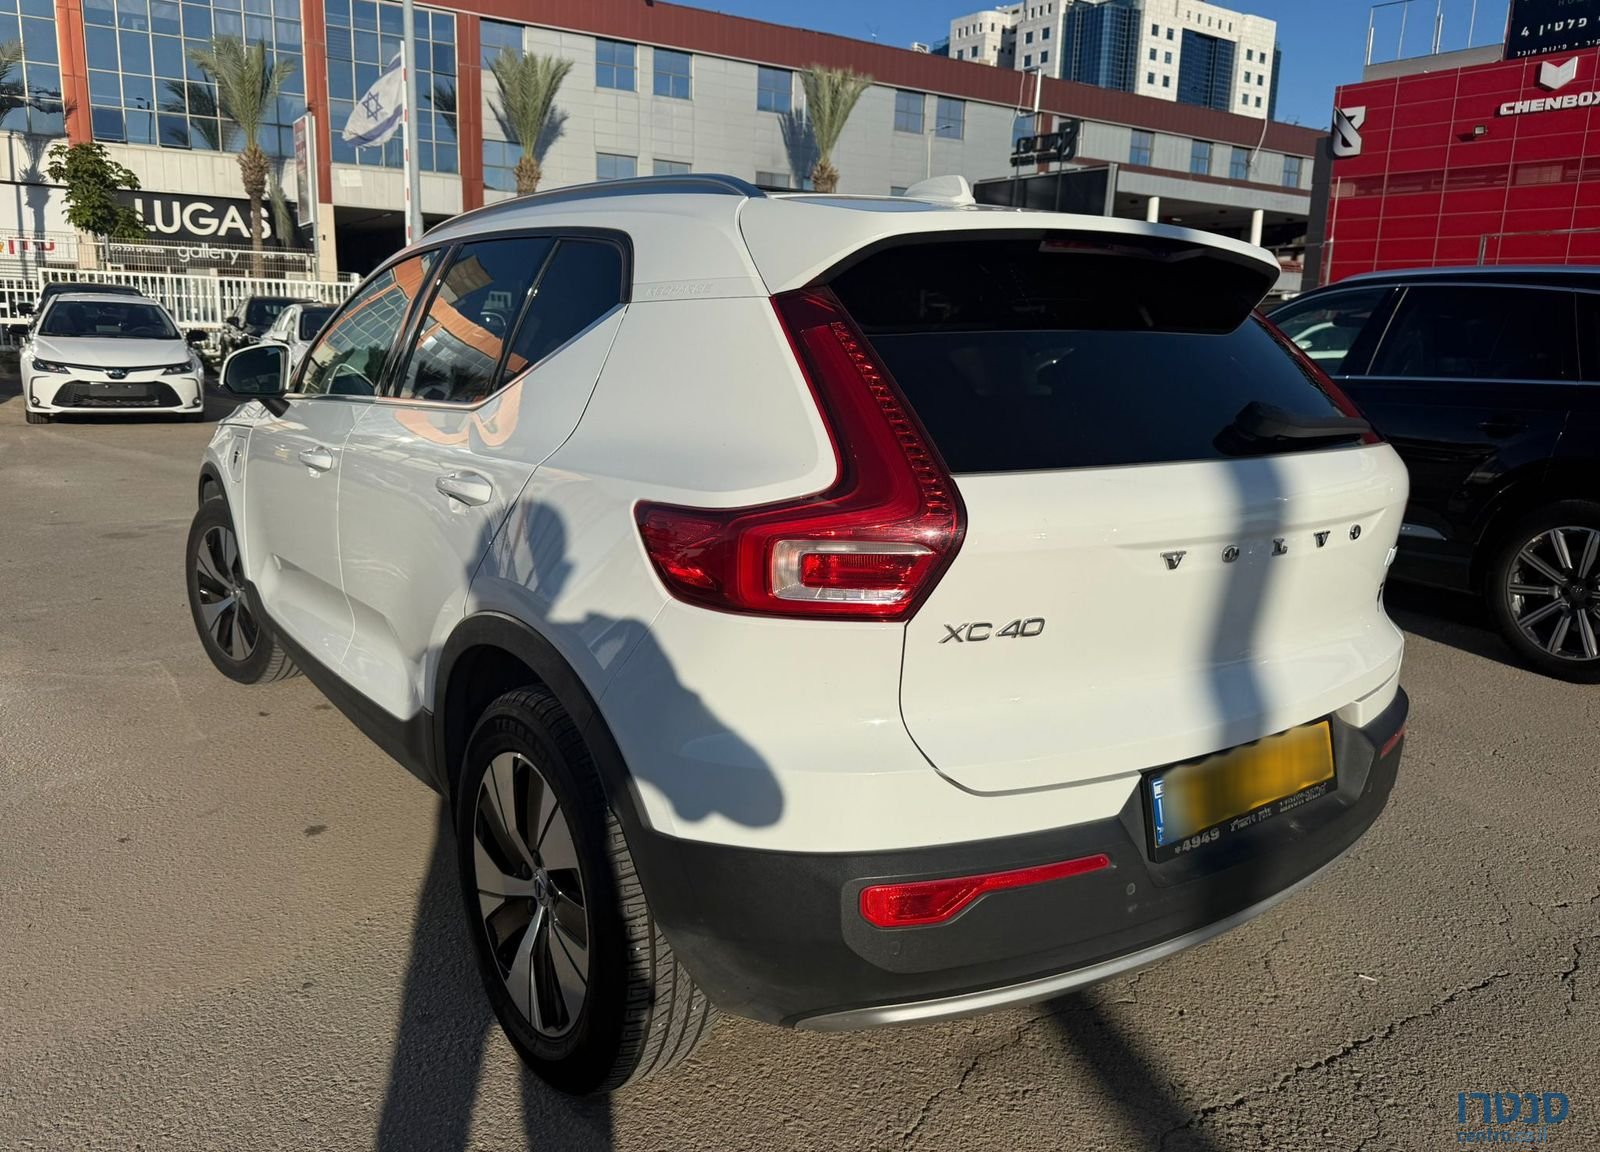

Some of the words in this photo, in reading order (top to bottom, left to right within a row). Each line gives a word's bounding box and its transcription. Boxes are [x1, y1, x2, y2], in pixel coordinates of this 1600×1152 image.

[1521, 26, 1530, 37] 4
[134, 198, 272, 239] LUGAS
[177, 243, 240, 265] gallery
[1159, 523, 1363, 571] VOLVO
